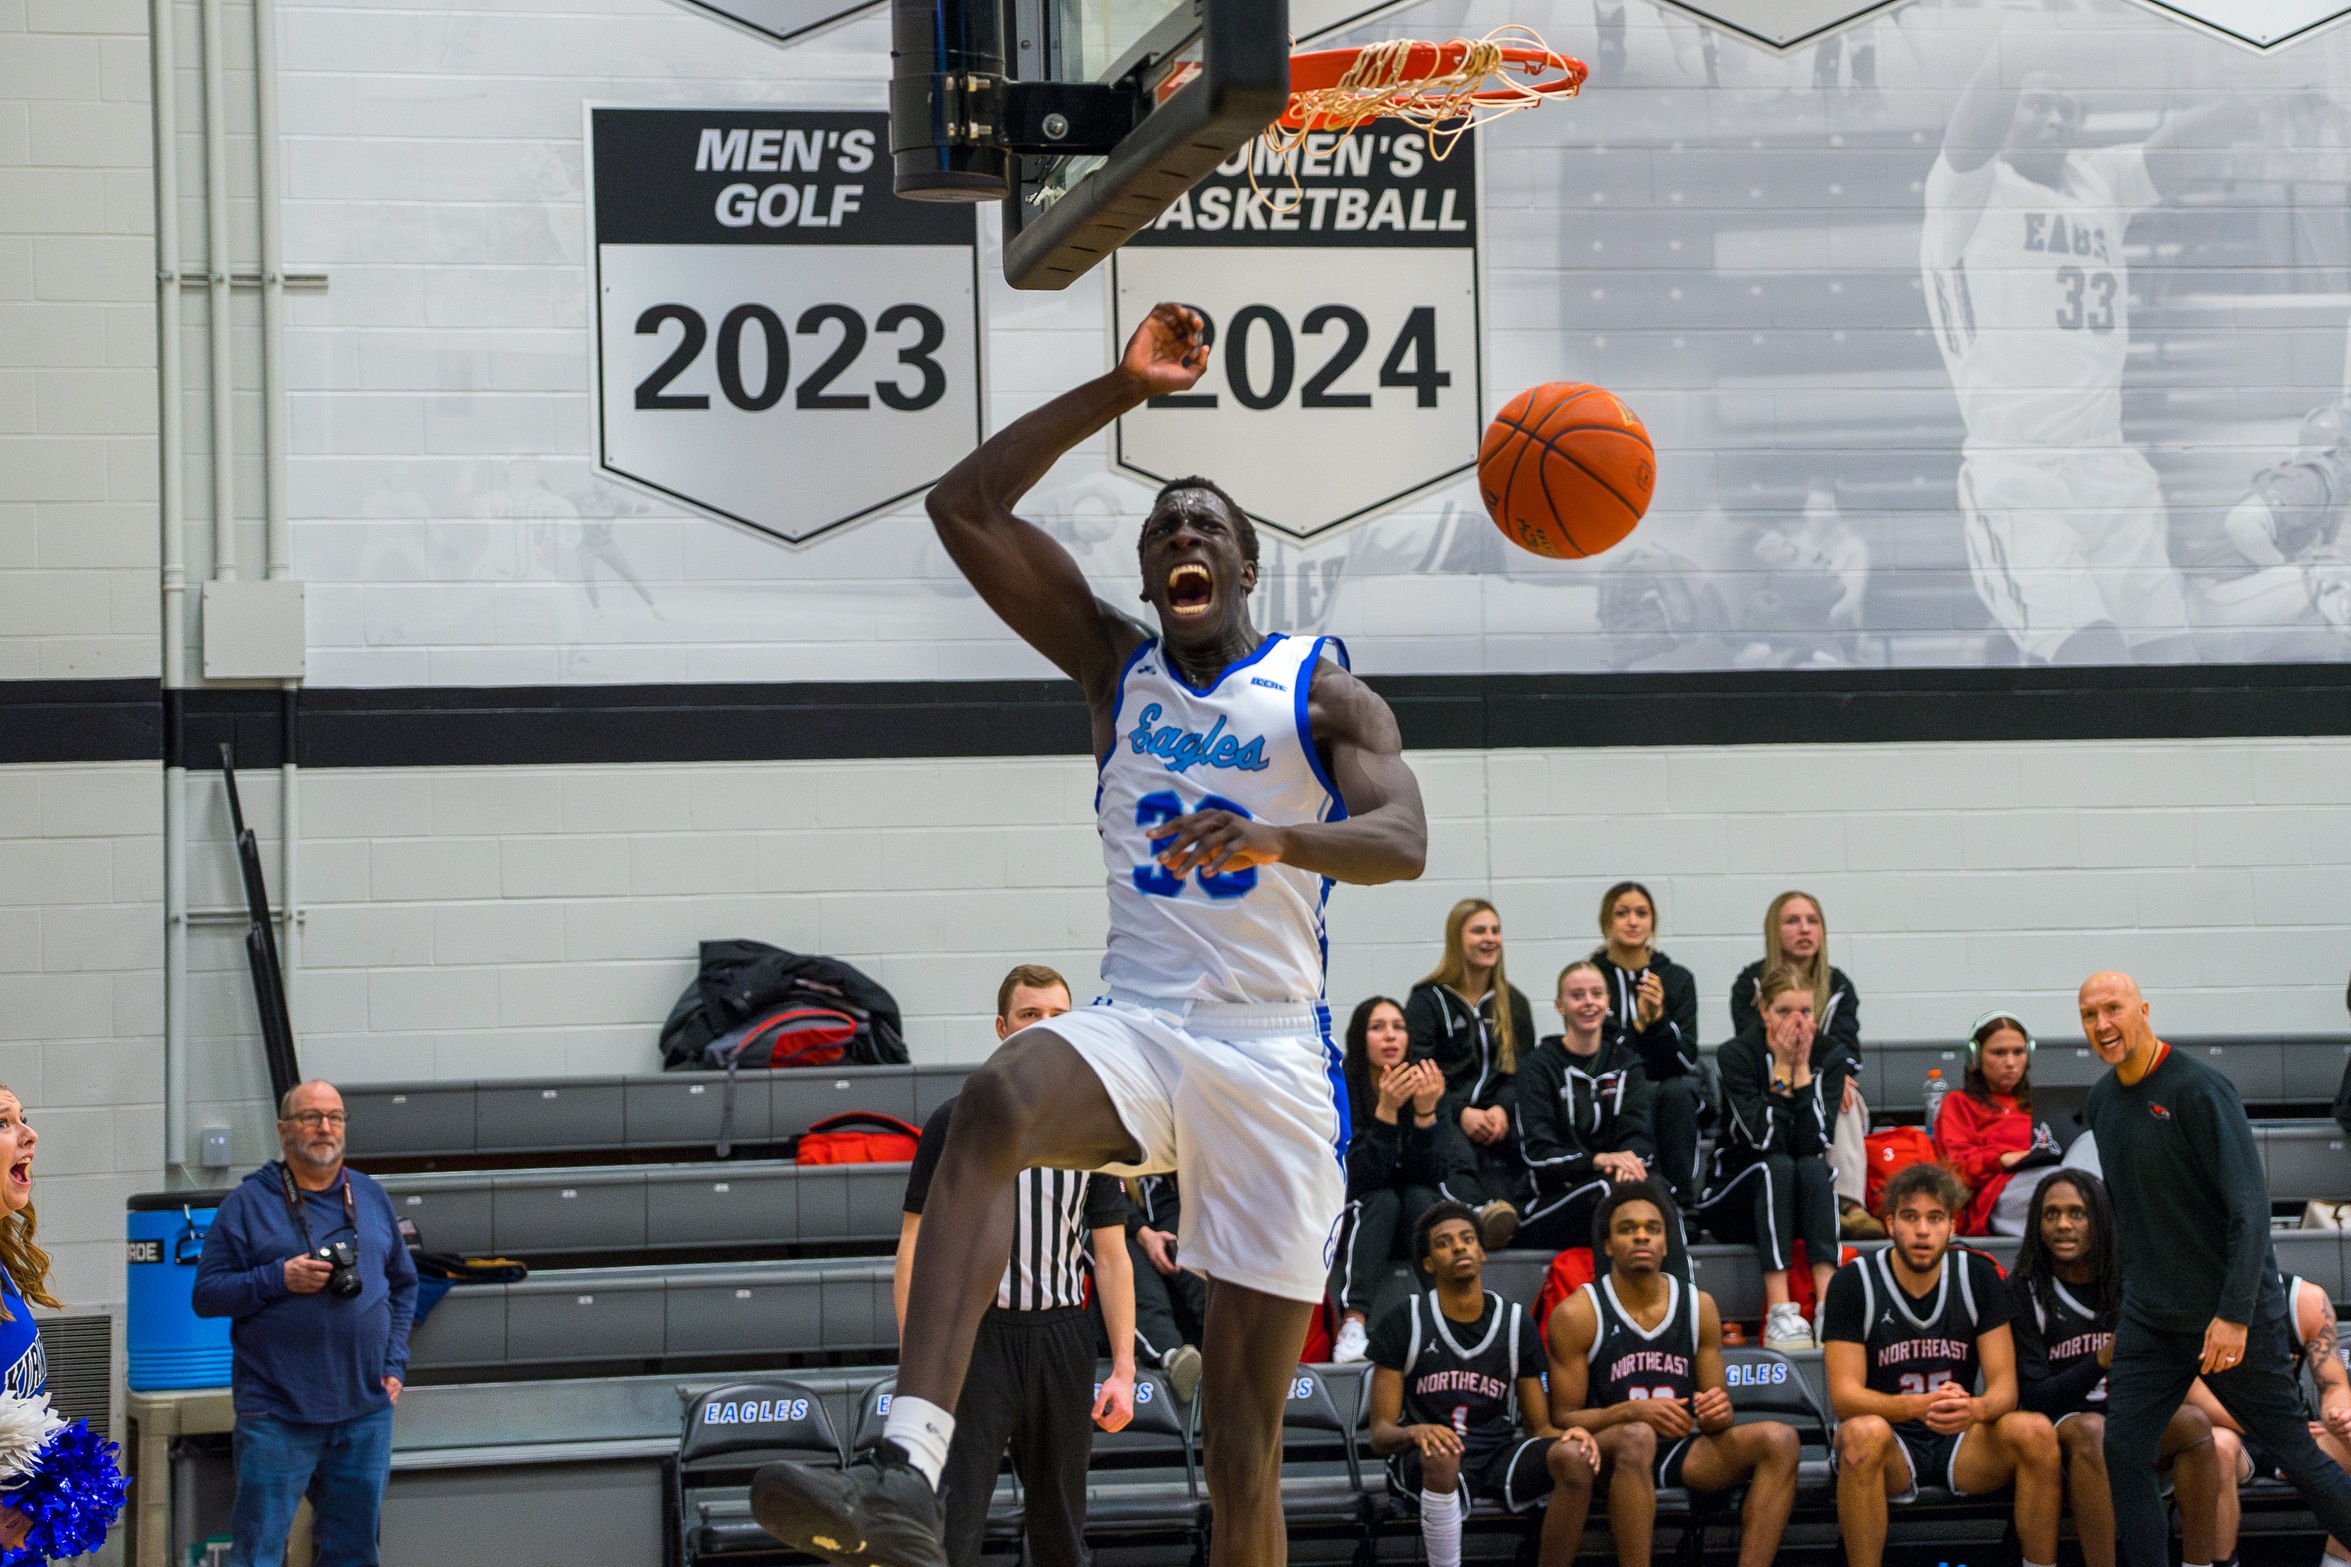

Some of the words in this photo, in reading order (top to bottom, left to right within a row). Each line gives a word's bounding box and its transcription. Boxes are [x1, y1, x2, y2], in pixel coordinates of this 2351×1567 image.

[694, 128, 876, 173] MEN'S
[1215, 133, 1426, 178] OMEN'S
[714, 183, 865, 228] GOLF
[1140, 186, 1468, 231] ASKETBALL
[2055, 265, 2118, 336] 33
[633, 302, 947, 412] 2023
[1128, 702, 1270, 773] Eagles
[1609, 1350, 1689, 1383] NORTHEAST
[1725, 1362, 1788, 1387] GLES
[1878, 1338, 1969, 1368] NORTHEAST
[1415, 1369, 1508, 1401] NORTHEAST
[703, 1398, 809, 1425] EAGLES
